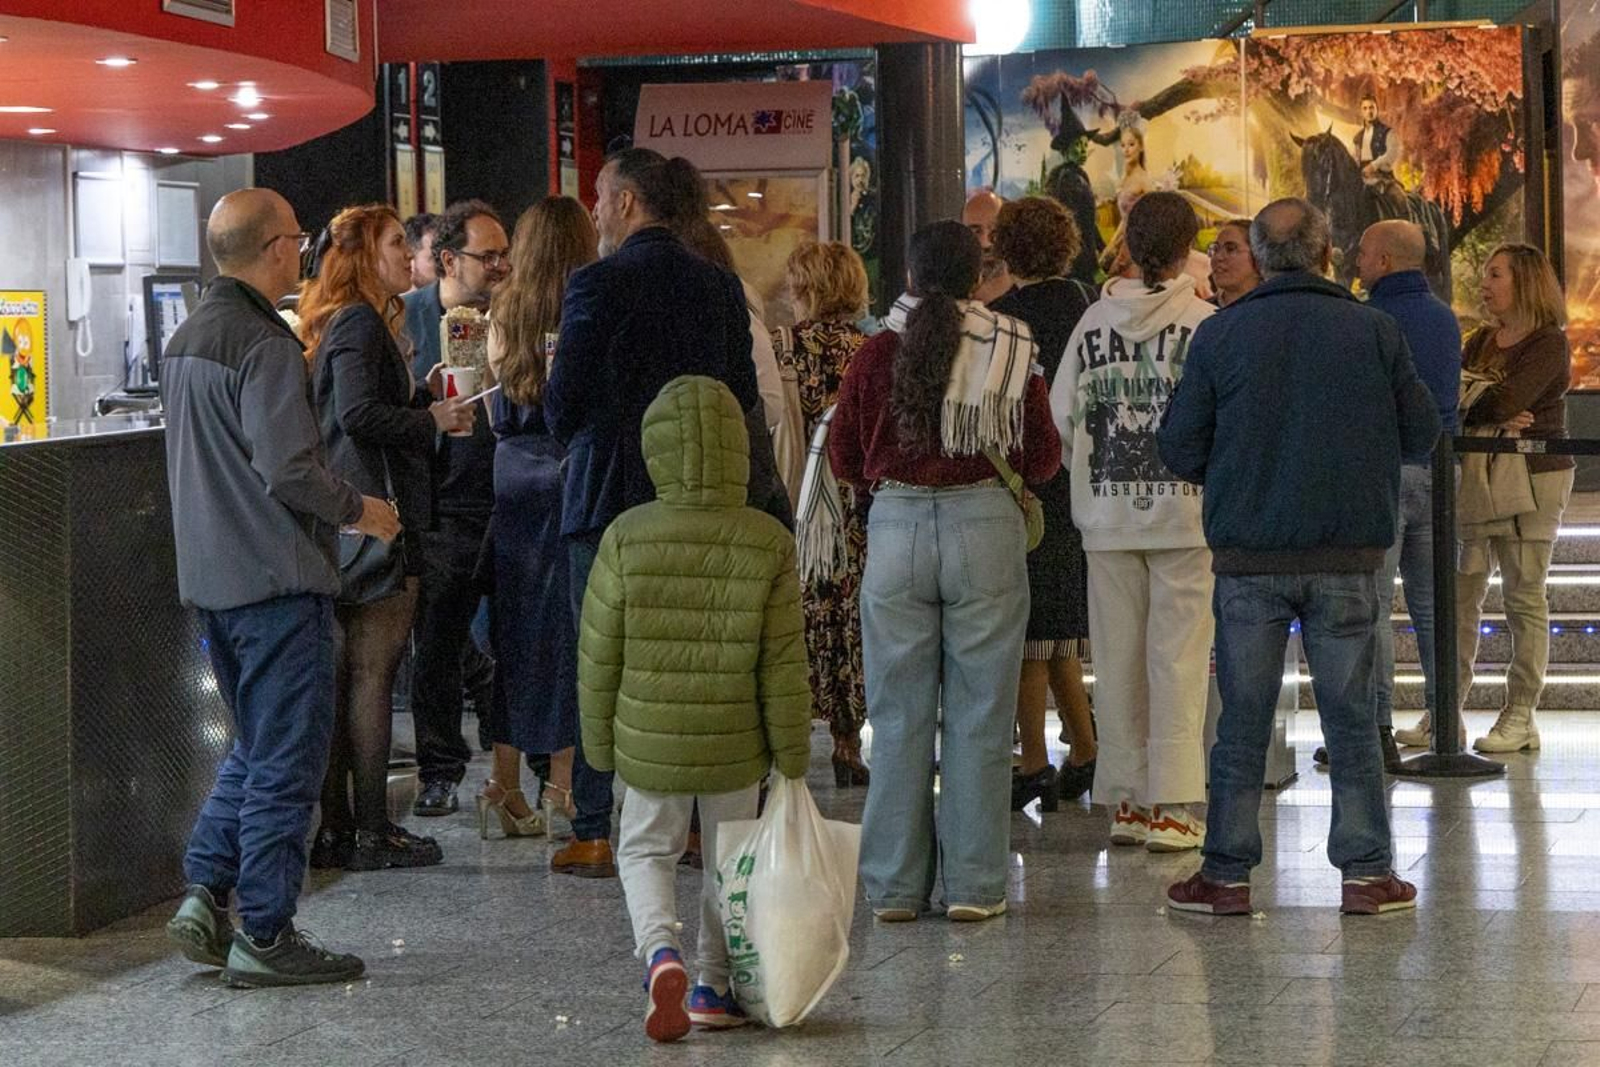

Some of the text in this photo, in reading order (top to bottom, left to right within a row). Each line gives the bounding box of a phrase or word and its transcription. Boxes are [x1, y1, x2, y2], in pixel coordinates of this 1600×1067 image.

[397, 67, 406, 105] 1
[423, 70, 437, 107] 2
[650, 112, 749, 138] LA LOMA
[783, 112, 815, 130] CINE
[1091, 483, 1198, 498] WASHINGTON
